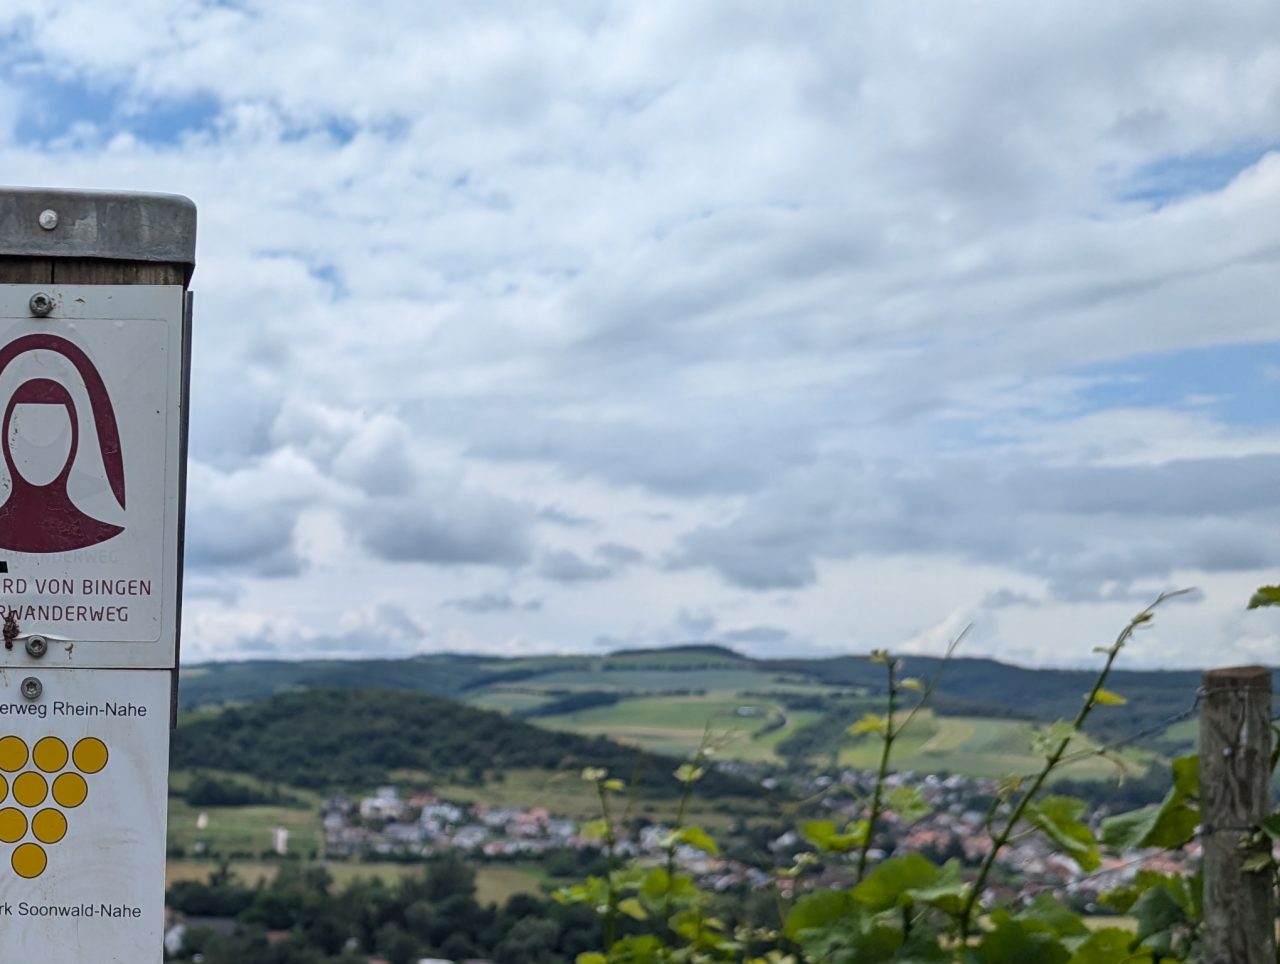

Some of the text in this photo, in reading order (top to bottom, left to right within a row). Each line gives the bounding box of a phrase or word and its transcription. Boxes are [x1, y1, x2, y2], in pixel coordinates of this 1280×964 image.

[35, 578, 75, 595] VON
[81, 579, 152, 596] BINGEN
[52, 701, 148, 718] Rhein-Nahe
[18, 902, 142, 918] Soonwald-Nahe
